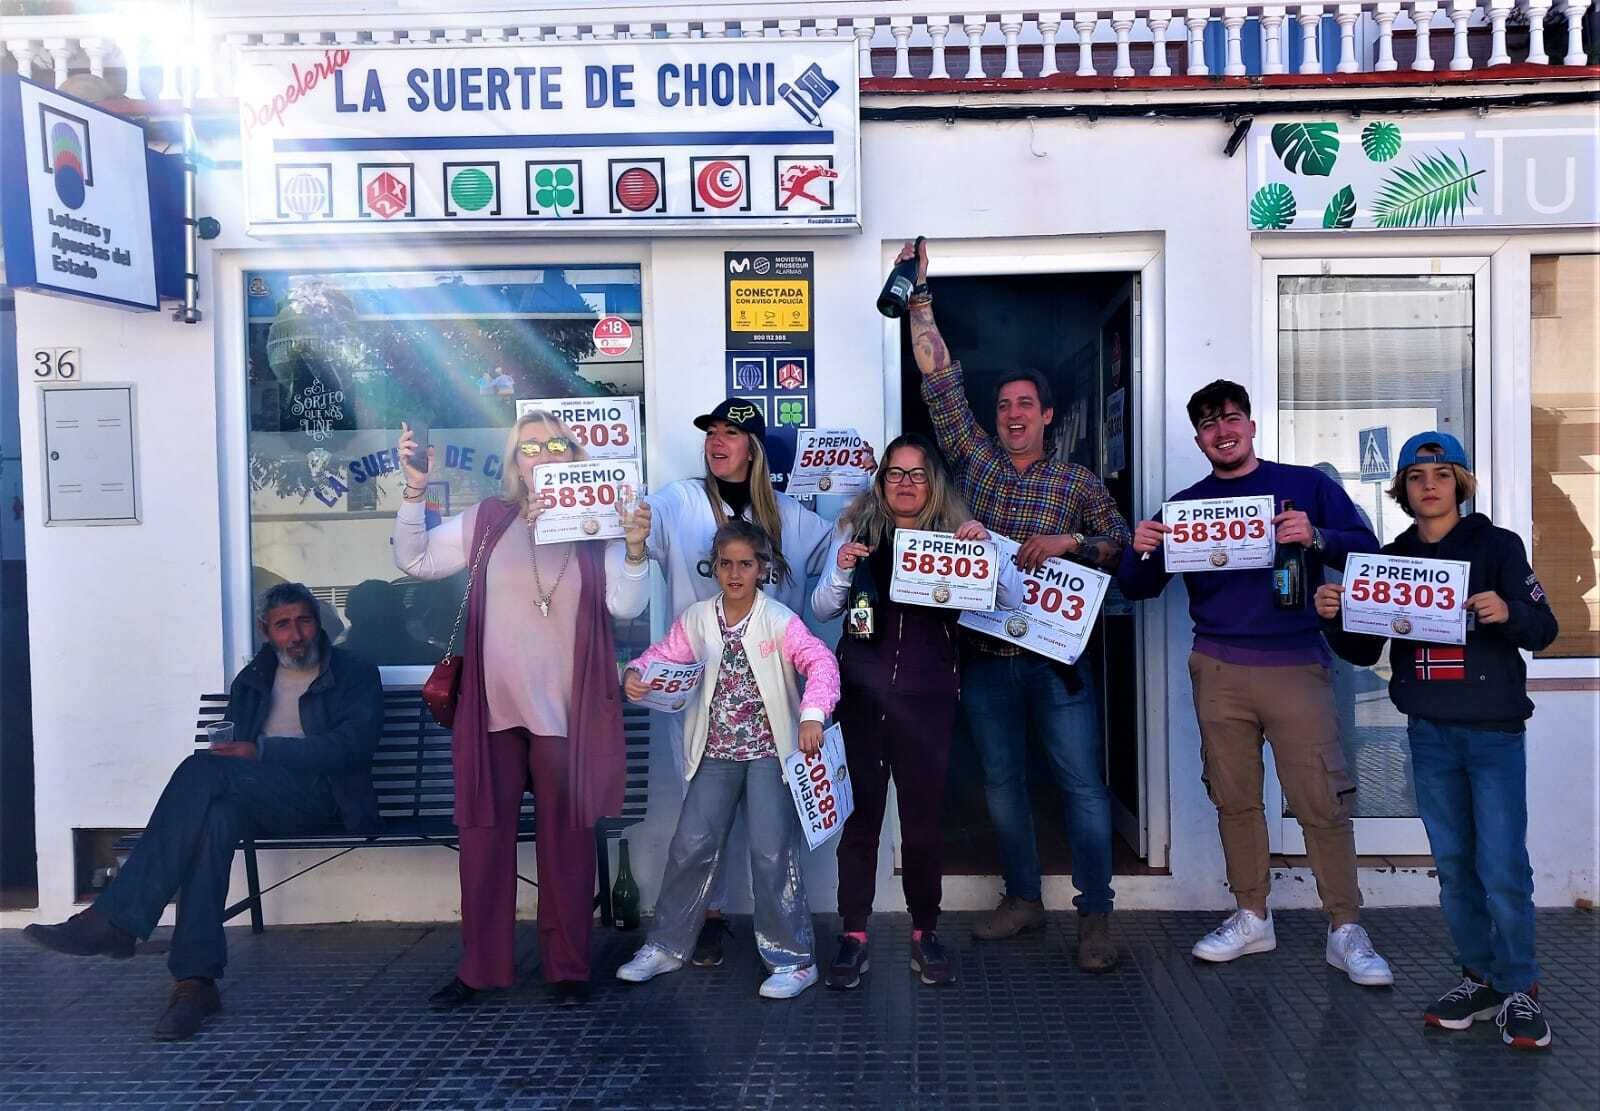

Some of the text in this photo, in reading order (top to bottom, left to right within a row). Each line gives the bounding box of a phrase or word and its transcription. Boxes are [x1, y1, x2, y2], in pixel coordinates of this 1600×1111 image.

[334, 62, 775, 113] LA SUERTE DE CHONI
[48, 208, 111, 244] Loterías y
[52, 232, 131, 267] Apuestas del
[52, 254, 97, 279] Estado
[735, 288, 804, 298] CONECTADA
[778, 297, 804, 305] POLICÍA
[601, 320, 623, 334] +18
[34, 350, 75, 379] 36
[291, 391, 344, 416] SORTEO
[569, 423, 630, 447] 303
[818, 436, 862, 448] PREMIO
[800, 448, 864, 468] 58303
[313, 473, 350, 508] LA
[446, 444, 476, 472] DE
[558, 468, 626, 485] PREMIO
[1192, 505, 1258, 521] PREMIO
[1172, 519, 1265, 544] 58303
[922, 539, 985, 557] PREMIO
[901, 552, 989, 580] 58303
[1376, 565, 1451, 584] PREMIO
[1022, 579, 1085, 622] 303
[1351, 579, 1456, 611] 58303
[794, 763, 819, 821] PREMIO
